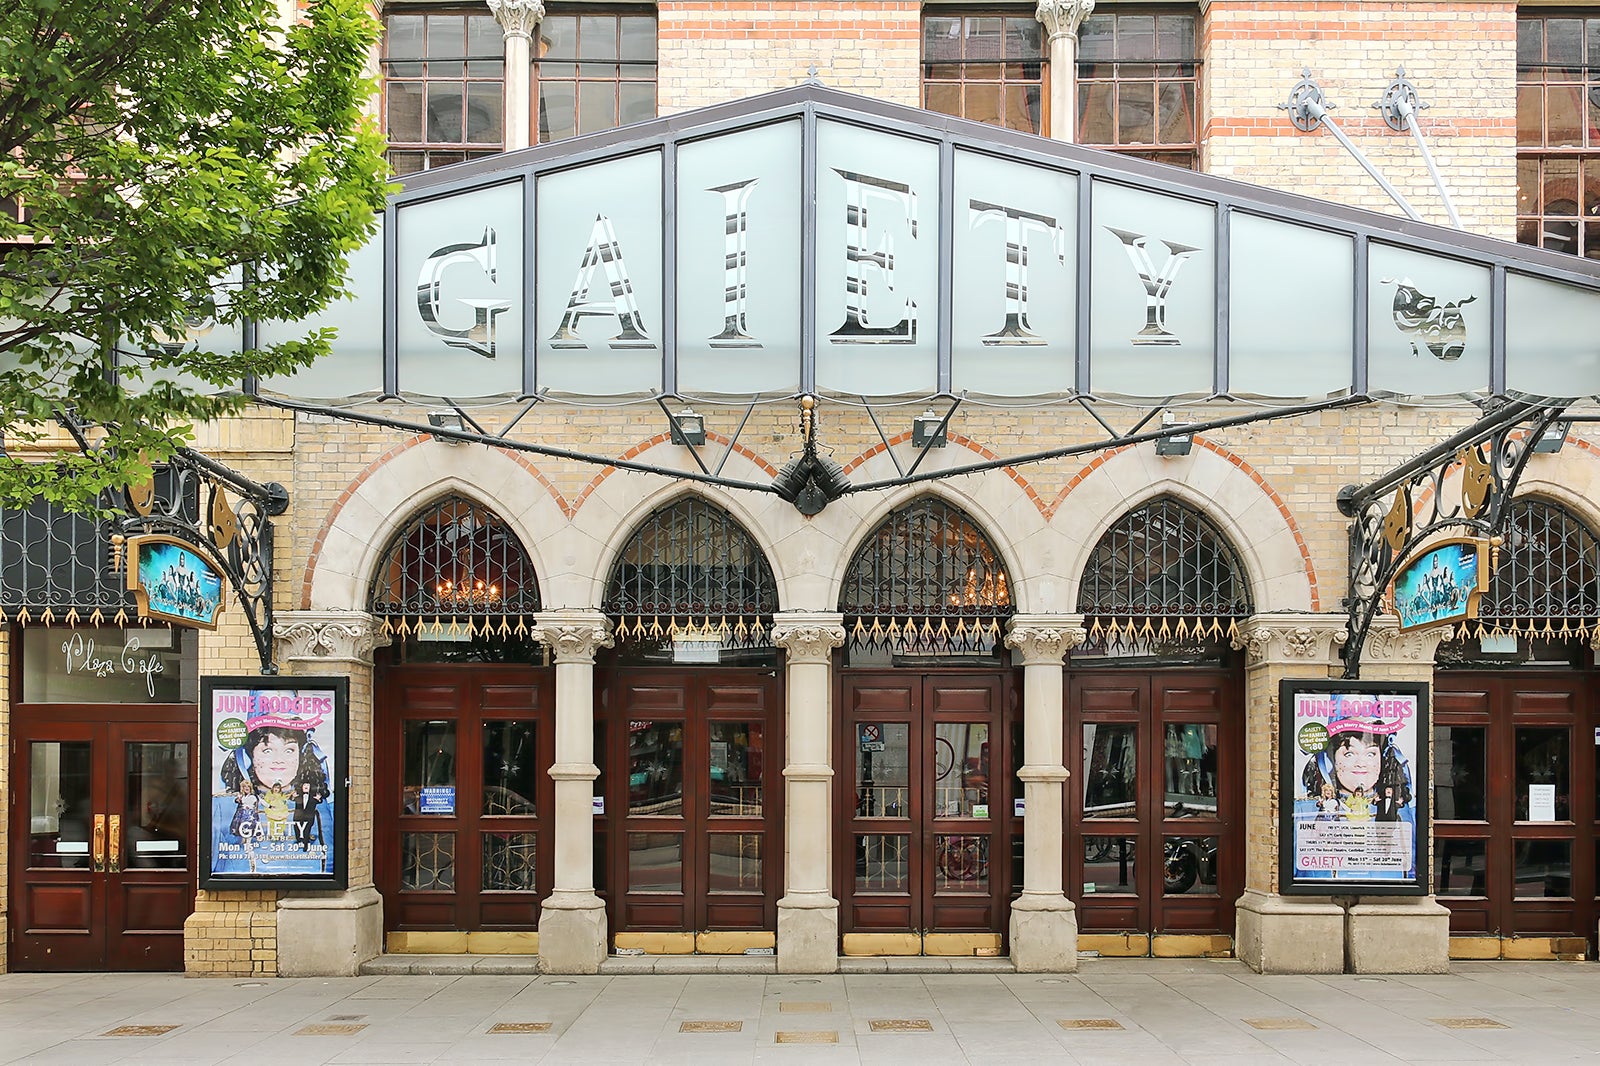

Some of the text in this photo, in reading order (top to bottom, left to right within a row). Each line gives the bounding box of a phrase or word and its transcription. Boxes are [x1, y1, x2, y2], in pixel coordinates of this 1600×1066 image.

[416, 167, 1203, 360] GAIETY
[62, 632, 164, 698] Plaza Cafe
[216, 695, 332, 714] JUNE RODGERS
[1297, 700, 1413, 718] JUNE RODGERS
[239, 821, 308, 839] GAIETY
[219, 842, 240, 851] Mon
[243, 842, 260, 852] 15th
[270, 842, 285, 852] Sat
[288, 842, 305, 852] 20th
[306, 842, 328, 852] June
[1301, 856, 1344, 867] GAIETY
